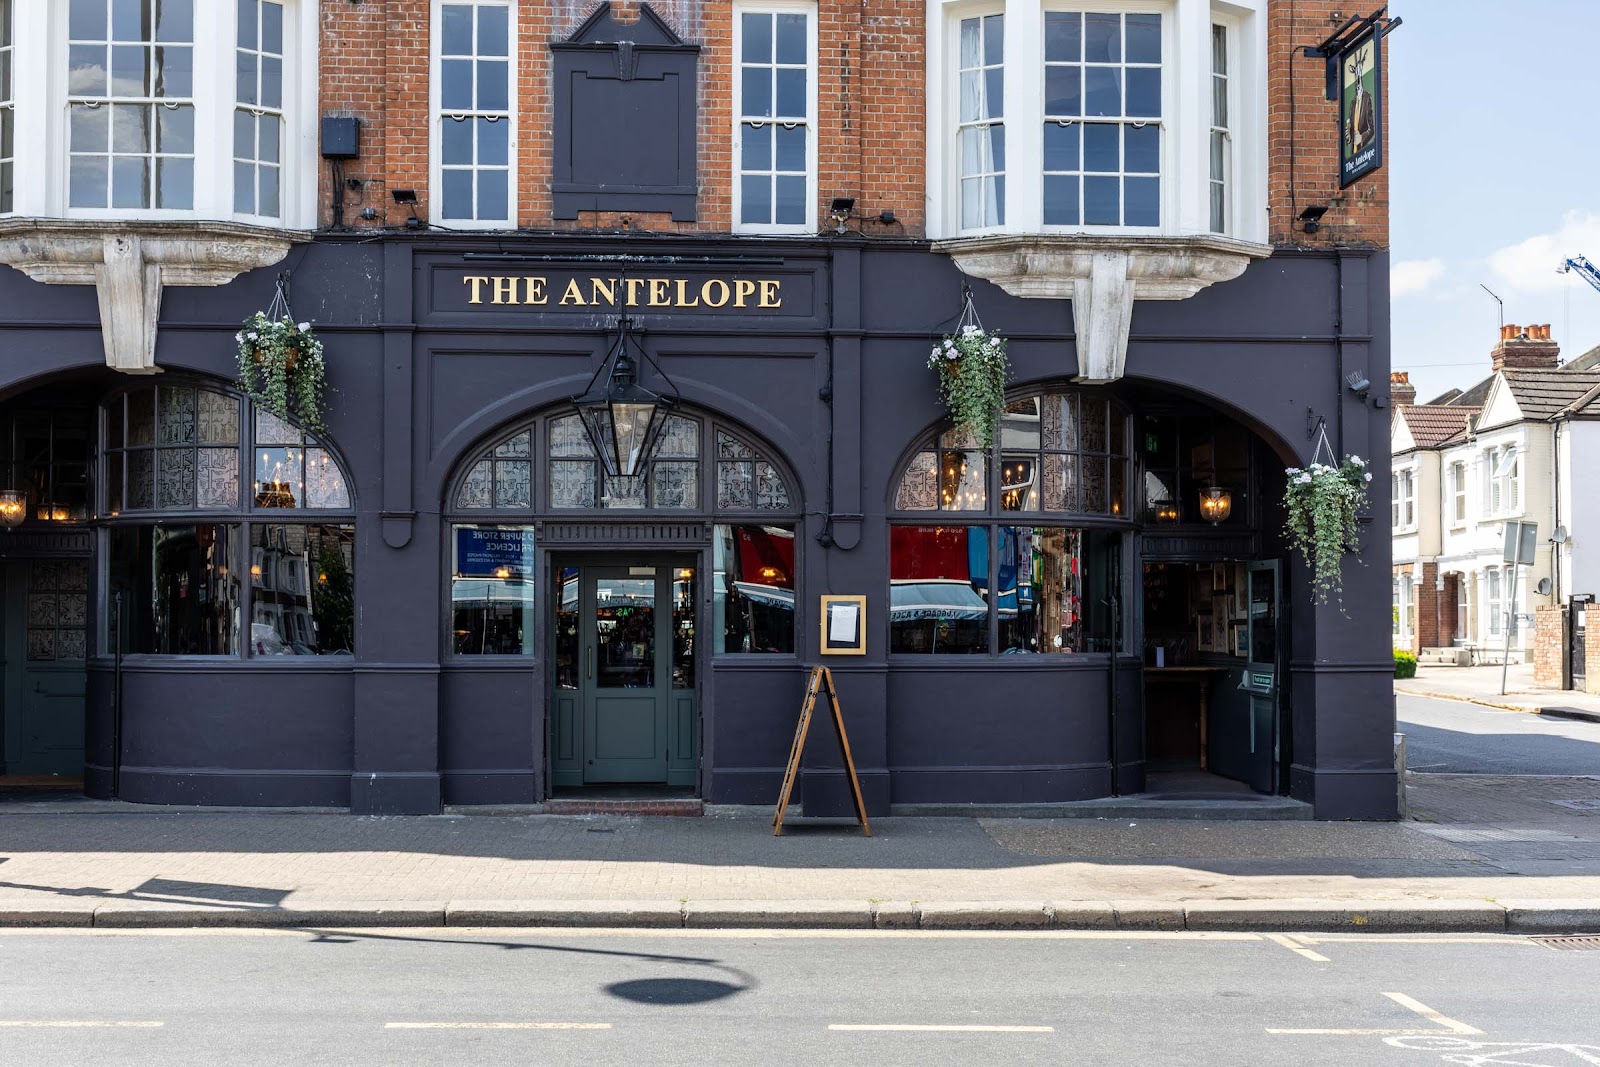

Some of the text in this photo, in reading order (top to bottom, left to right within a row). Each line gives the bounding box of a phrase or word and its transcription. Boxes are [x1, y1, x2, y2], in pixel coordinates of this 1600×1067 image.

[1345, 161, 1354, 173] The
[1356, 148, 1375, 165] Antelope
[463, 275, 782, 308] THE ANTELOPE
